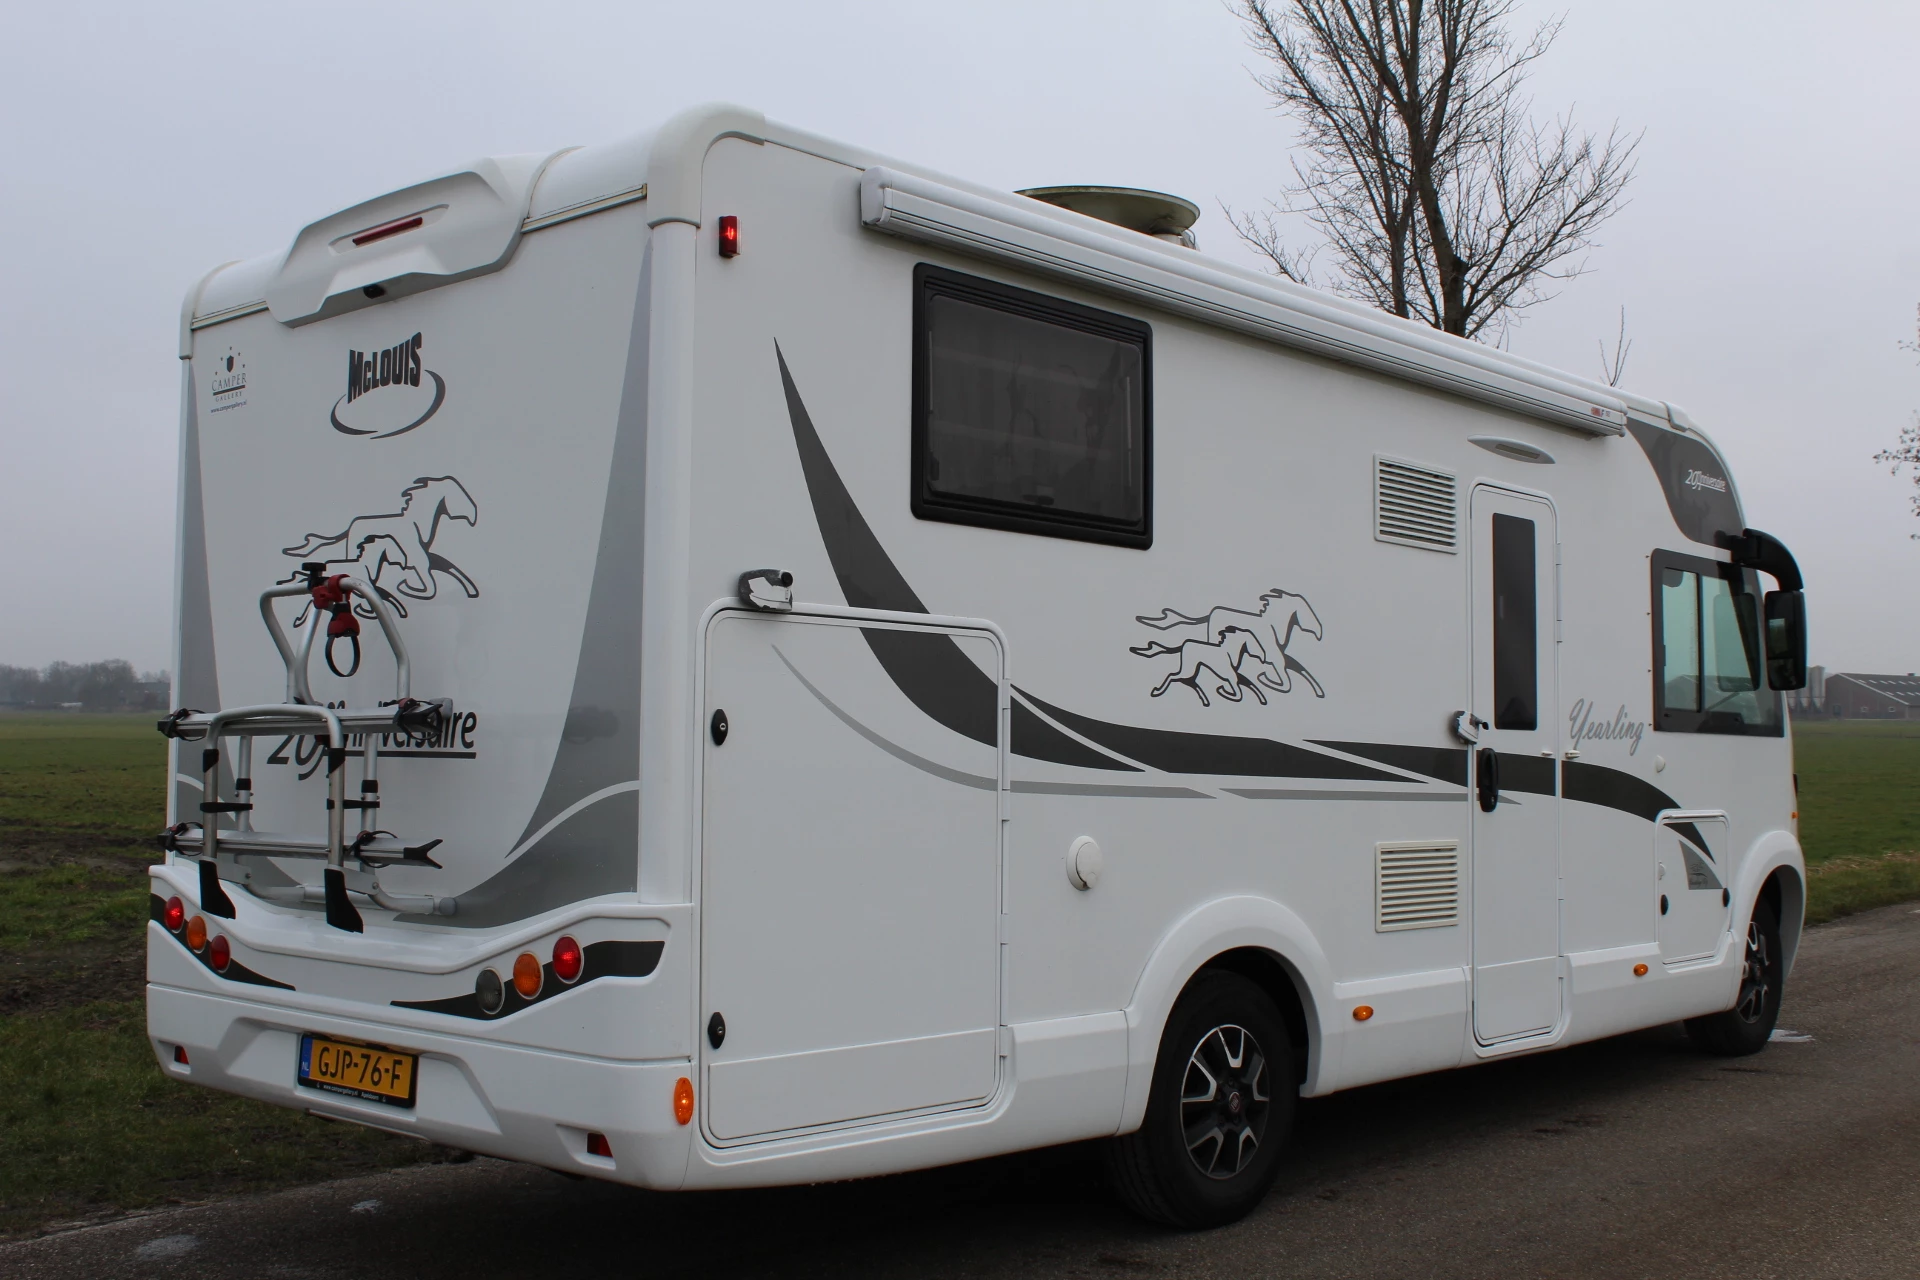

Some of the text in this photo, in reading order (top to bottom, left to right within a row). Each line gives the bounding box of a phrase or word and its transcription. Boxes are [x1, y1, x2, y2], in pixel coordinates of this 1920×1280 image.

[212, 372, 247, 391] CAMPER
[215, 391, 242, 402] GALLERY
[1569, 697, 1644, 756] Yearling
[301, 1061, 309, 1071] NL
[318, 1046, 403, 1089] GJP-76-F
